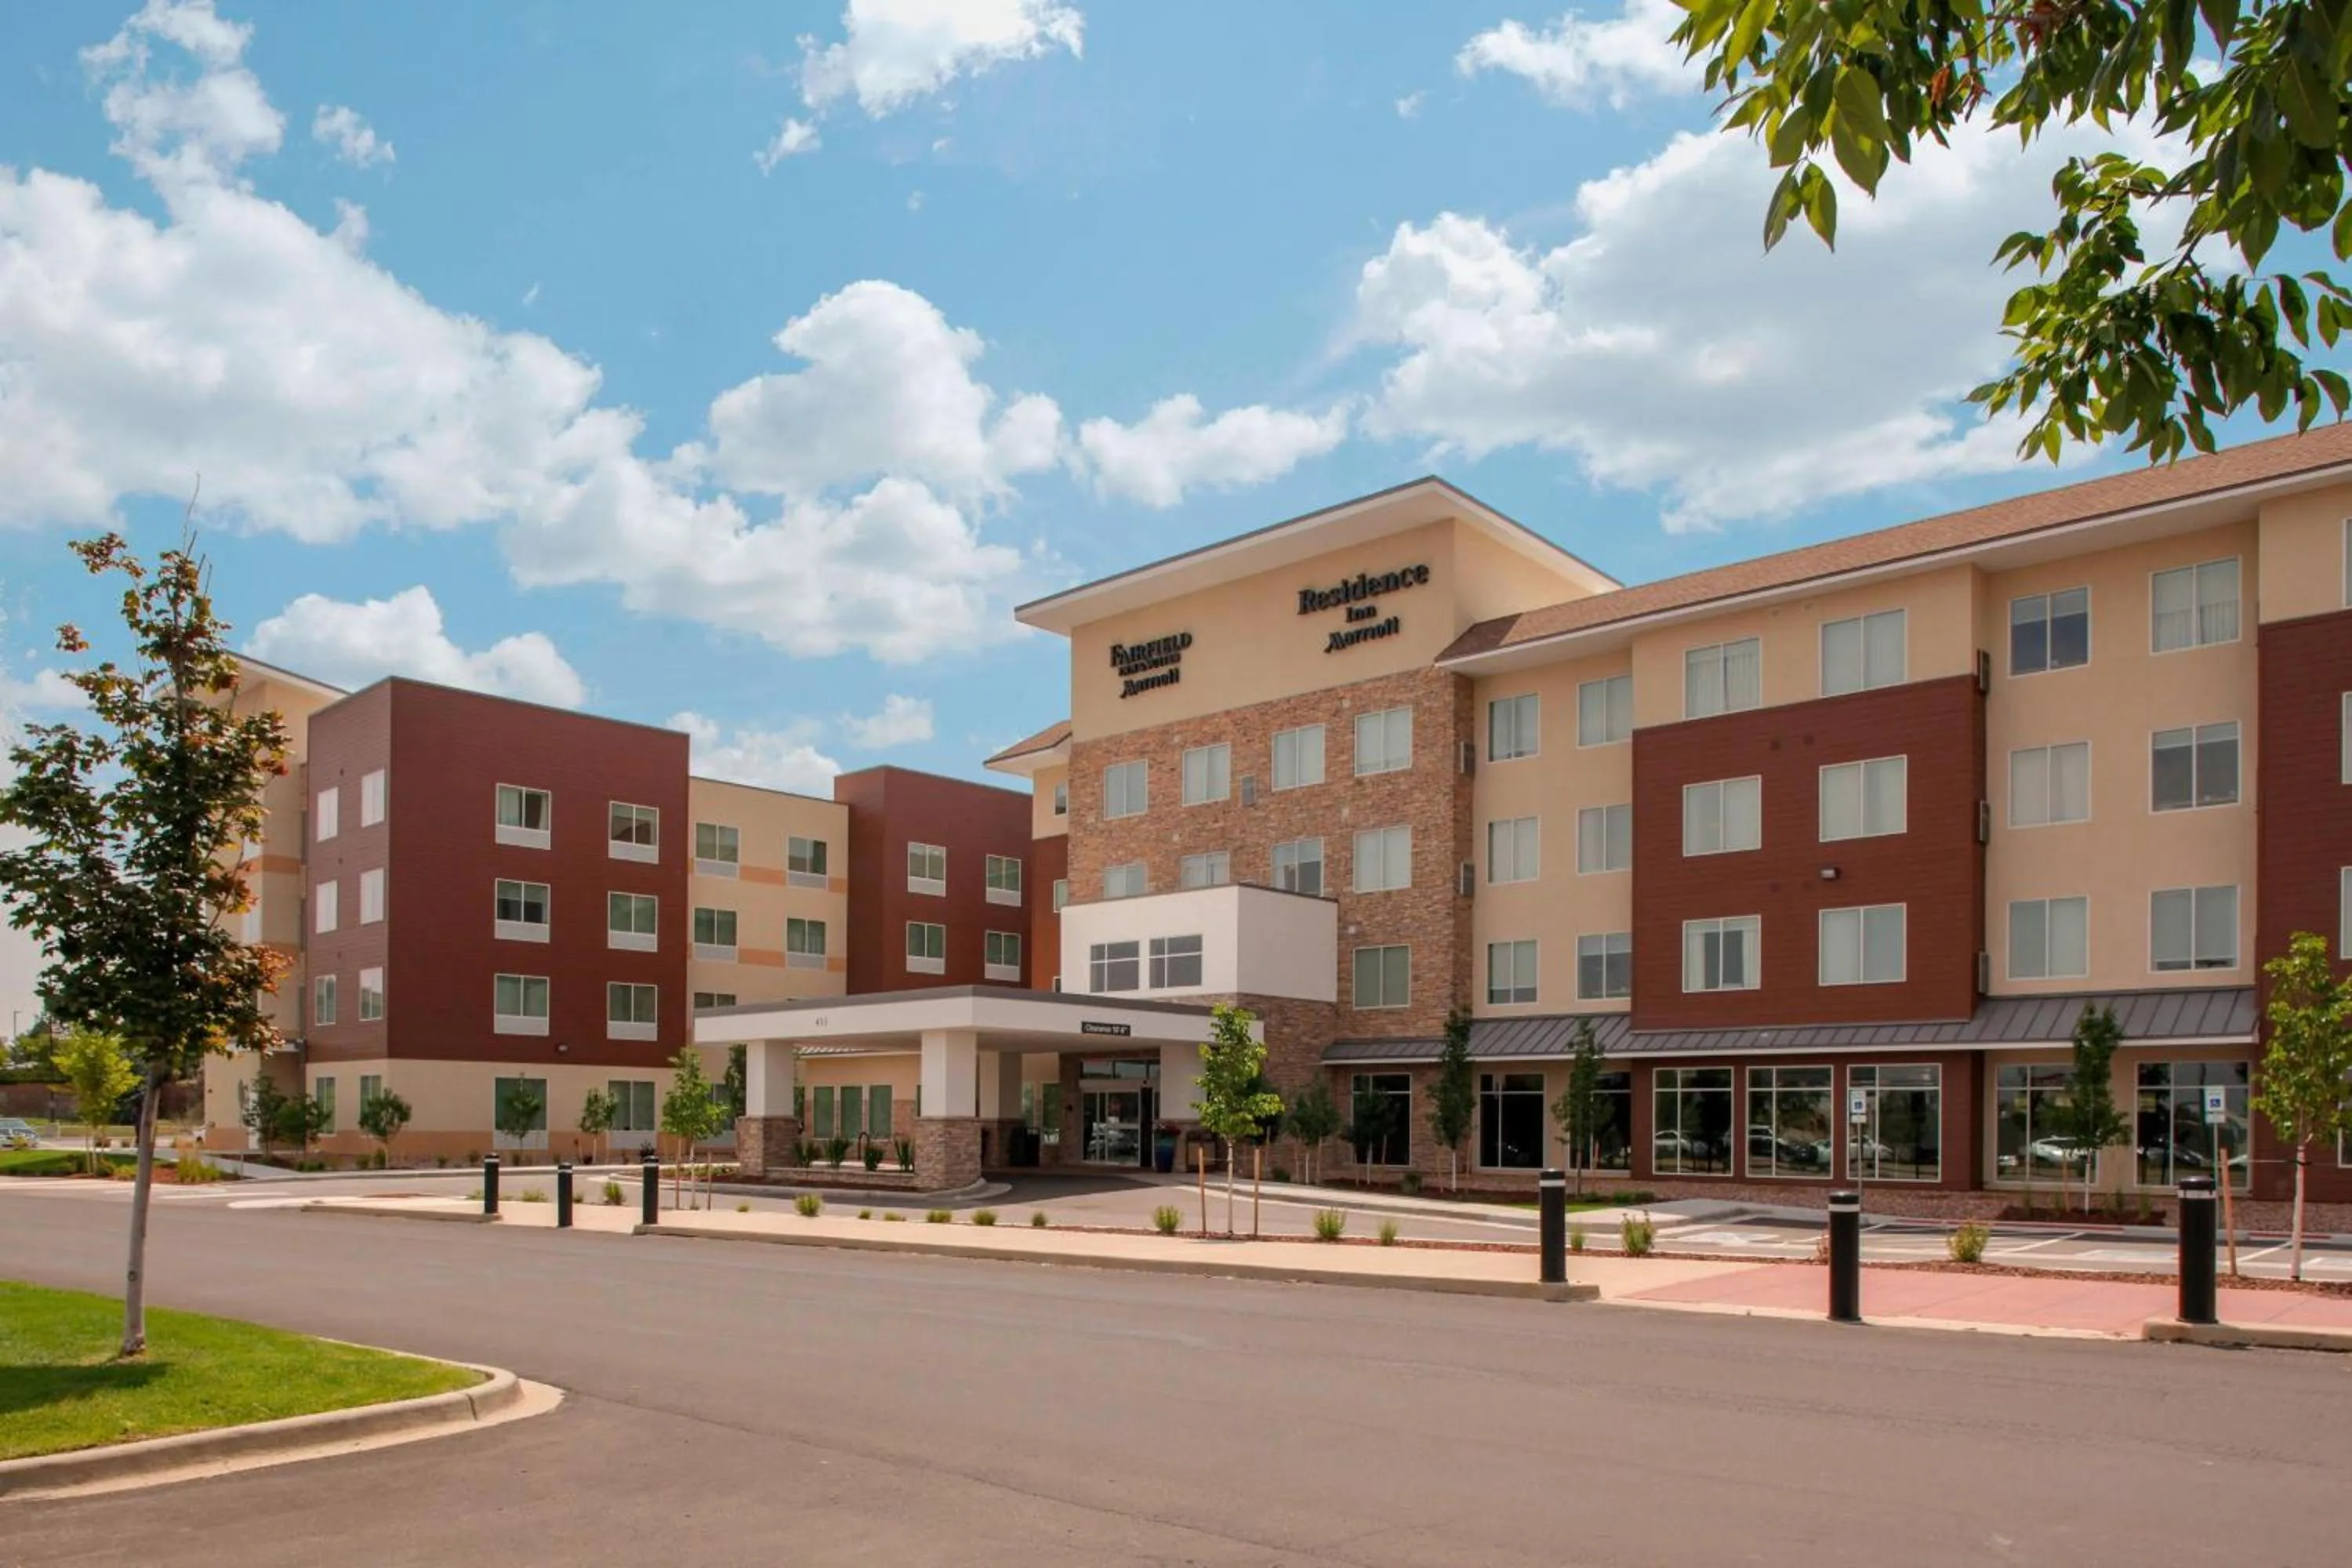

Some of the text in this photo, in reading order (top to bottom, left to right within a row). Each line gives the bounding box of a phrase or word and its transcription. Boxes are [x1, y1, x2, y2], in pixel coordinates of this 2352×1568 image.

[1298, 564, 1429, 615] Residence
[1345, 605, 1377, 622] Inn
[1323, 615, 1399, 654] Marriott
[1119, 667, 1179, 699] Marriott
